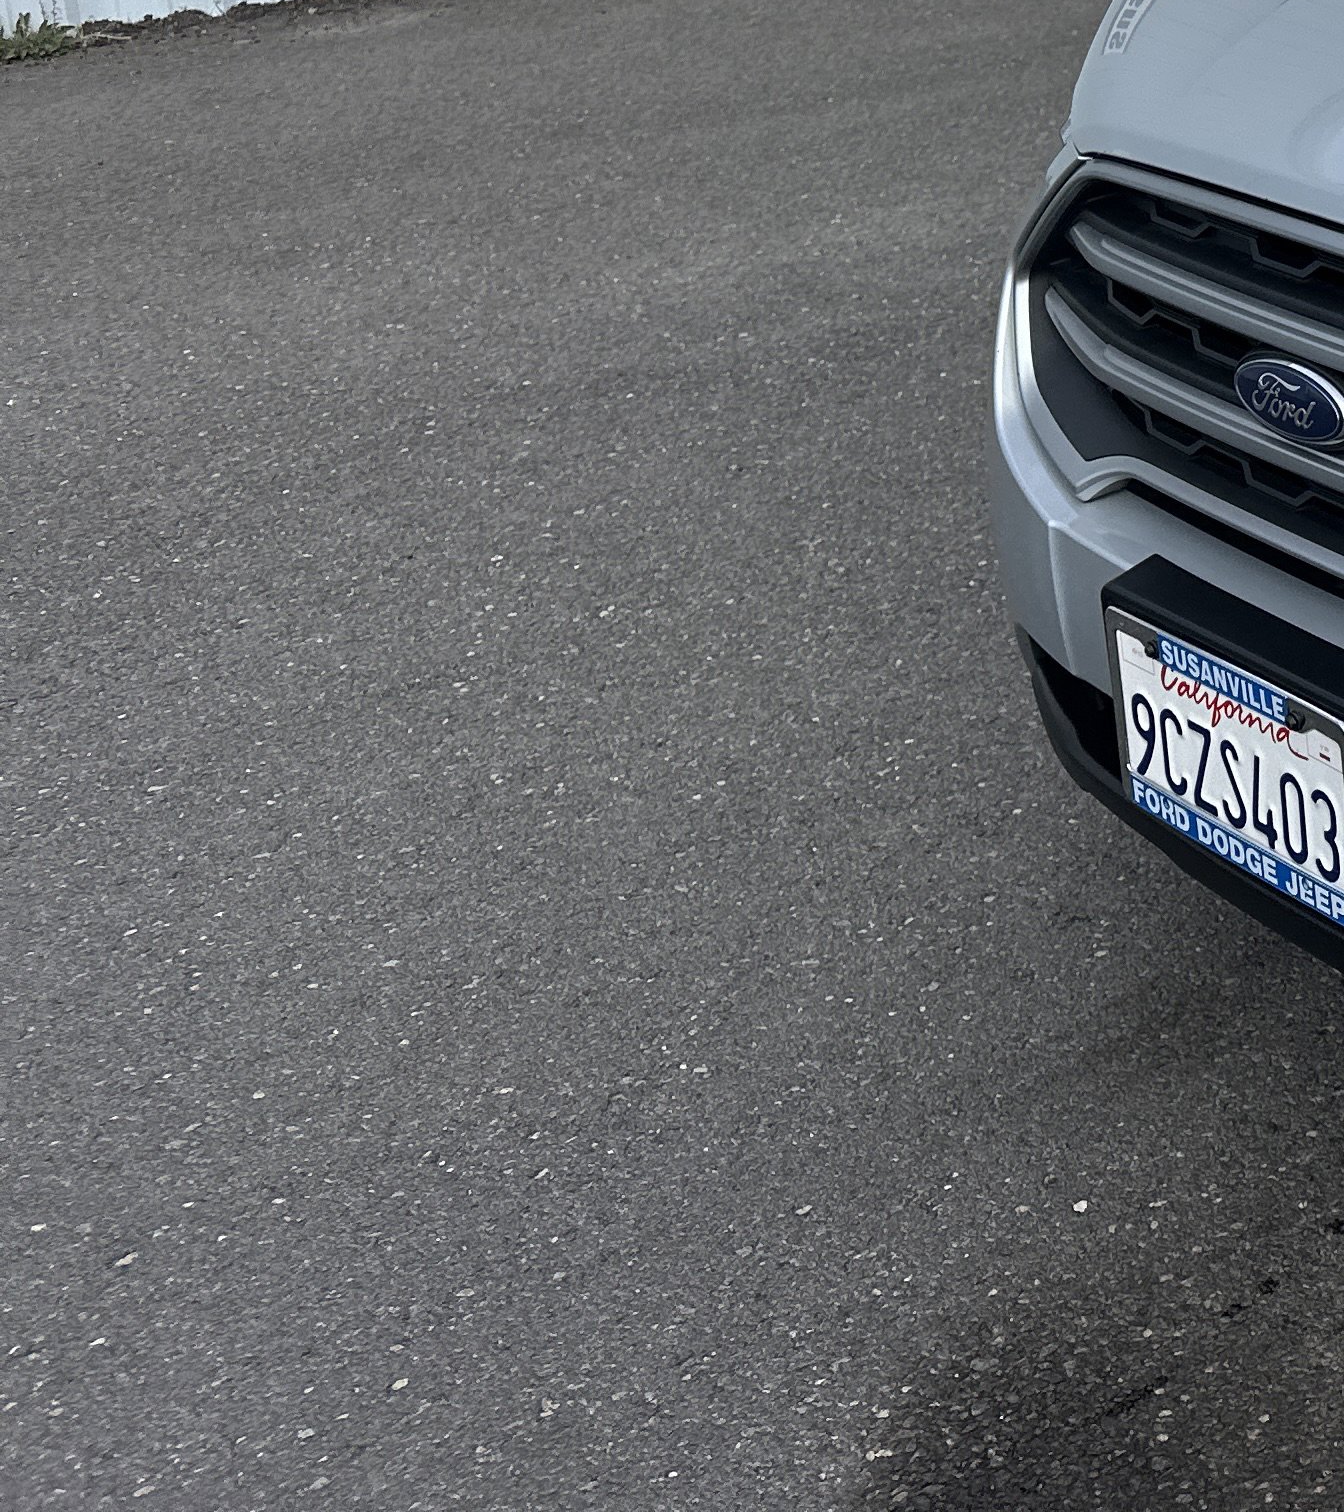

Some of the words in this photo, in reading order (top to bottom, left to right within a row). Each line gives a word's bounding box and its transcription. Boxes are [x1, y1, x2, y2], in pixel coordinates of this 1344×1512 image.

[1252, 372, 1317, 430] Ford
[1160, 639, 1287, 723] SUSANVILLE
[1160, 665, 1309, 761] California
[1131, 692, 1342, 883] 9CZS403
[1132, 778, 1190, 832] FORD
[1197, 819, 1278, 889] DODGE
